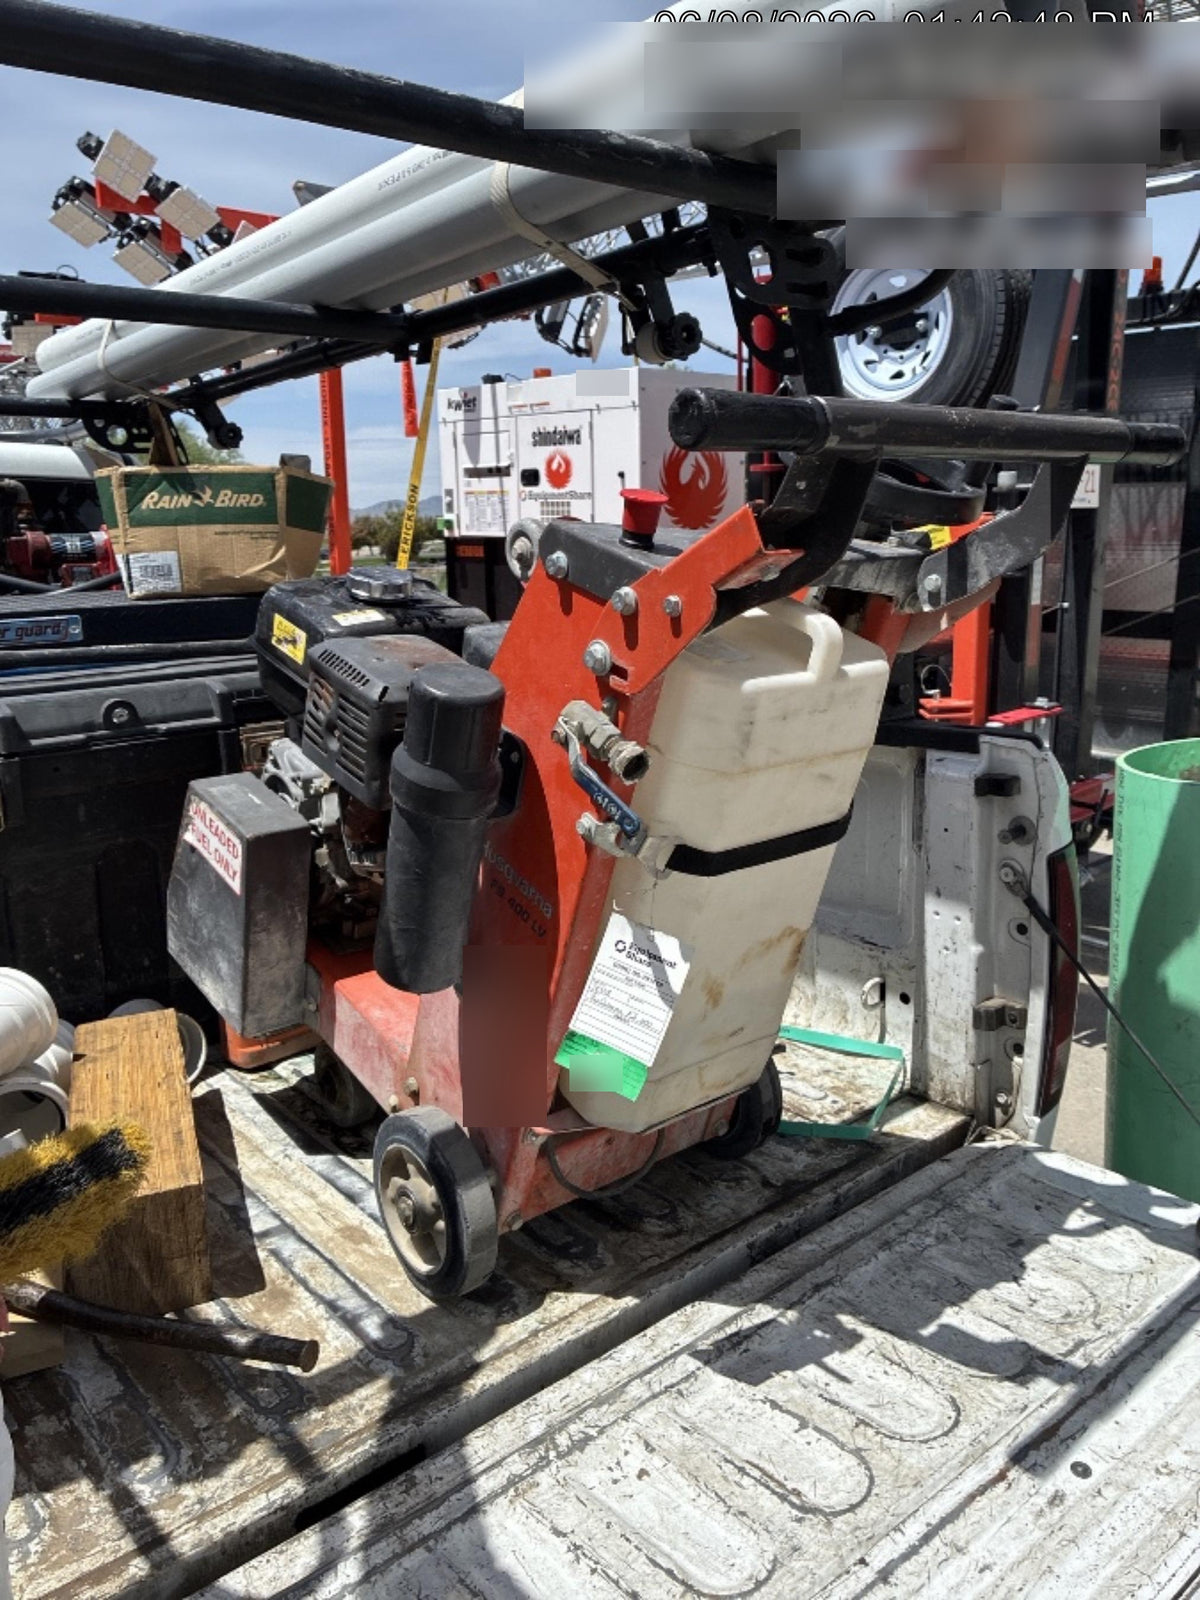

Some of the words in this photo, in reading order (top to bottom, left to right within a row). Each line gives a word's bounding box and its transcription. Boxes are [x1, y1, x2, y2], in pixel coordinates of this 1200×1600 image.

[531, 426, 582, 447] shindaiwa
[141, 491, 191, 510] RAIN
[214, 490, 264, 508] BIRD
[401, 483, 419, 553] ERICKSON
[191, 802, 239, 860] UNLEADED
[214, 847, 238, 882] ONLY
[507, 897, 530, 922] 400
